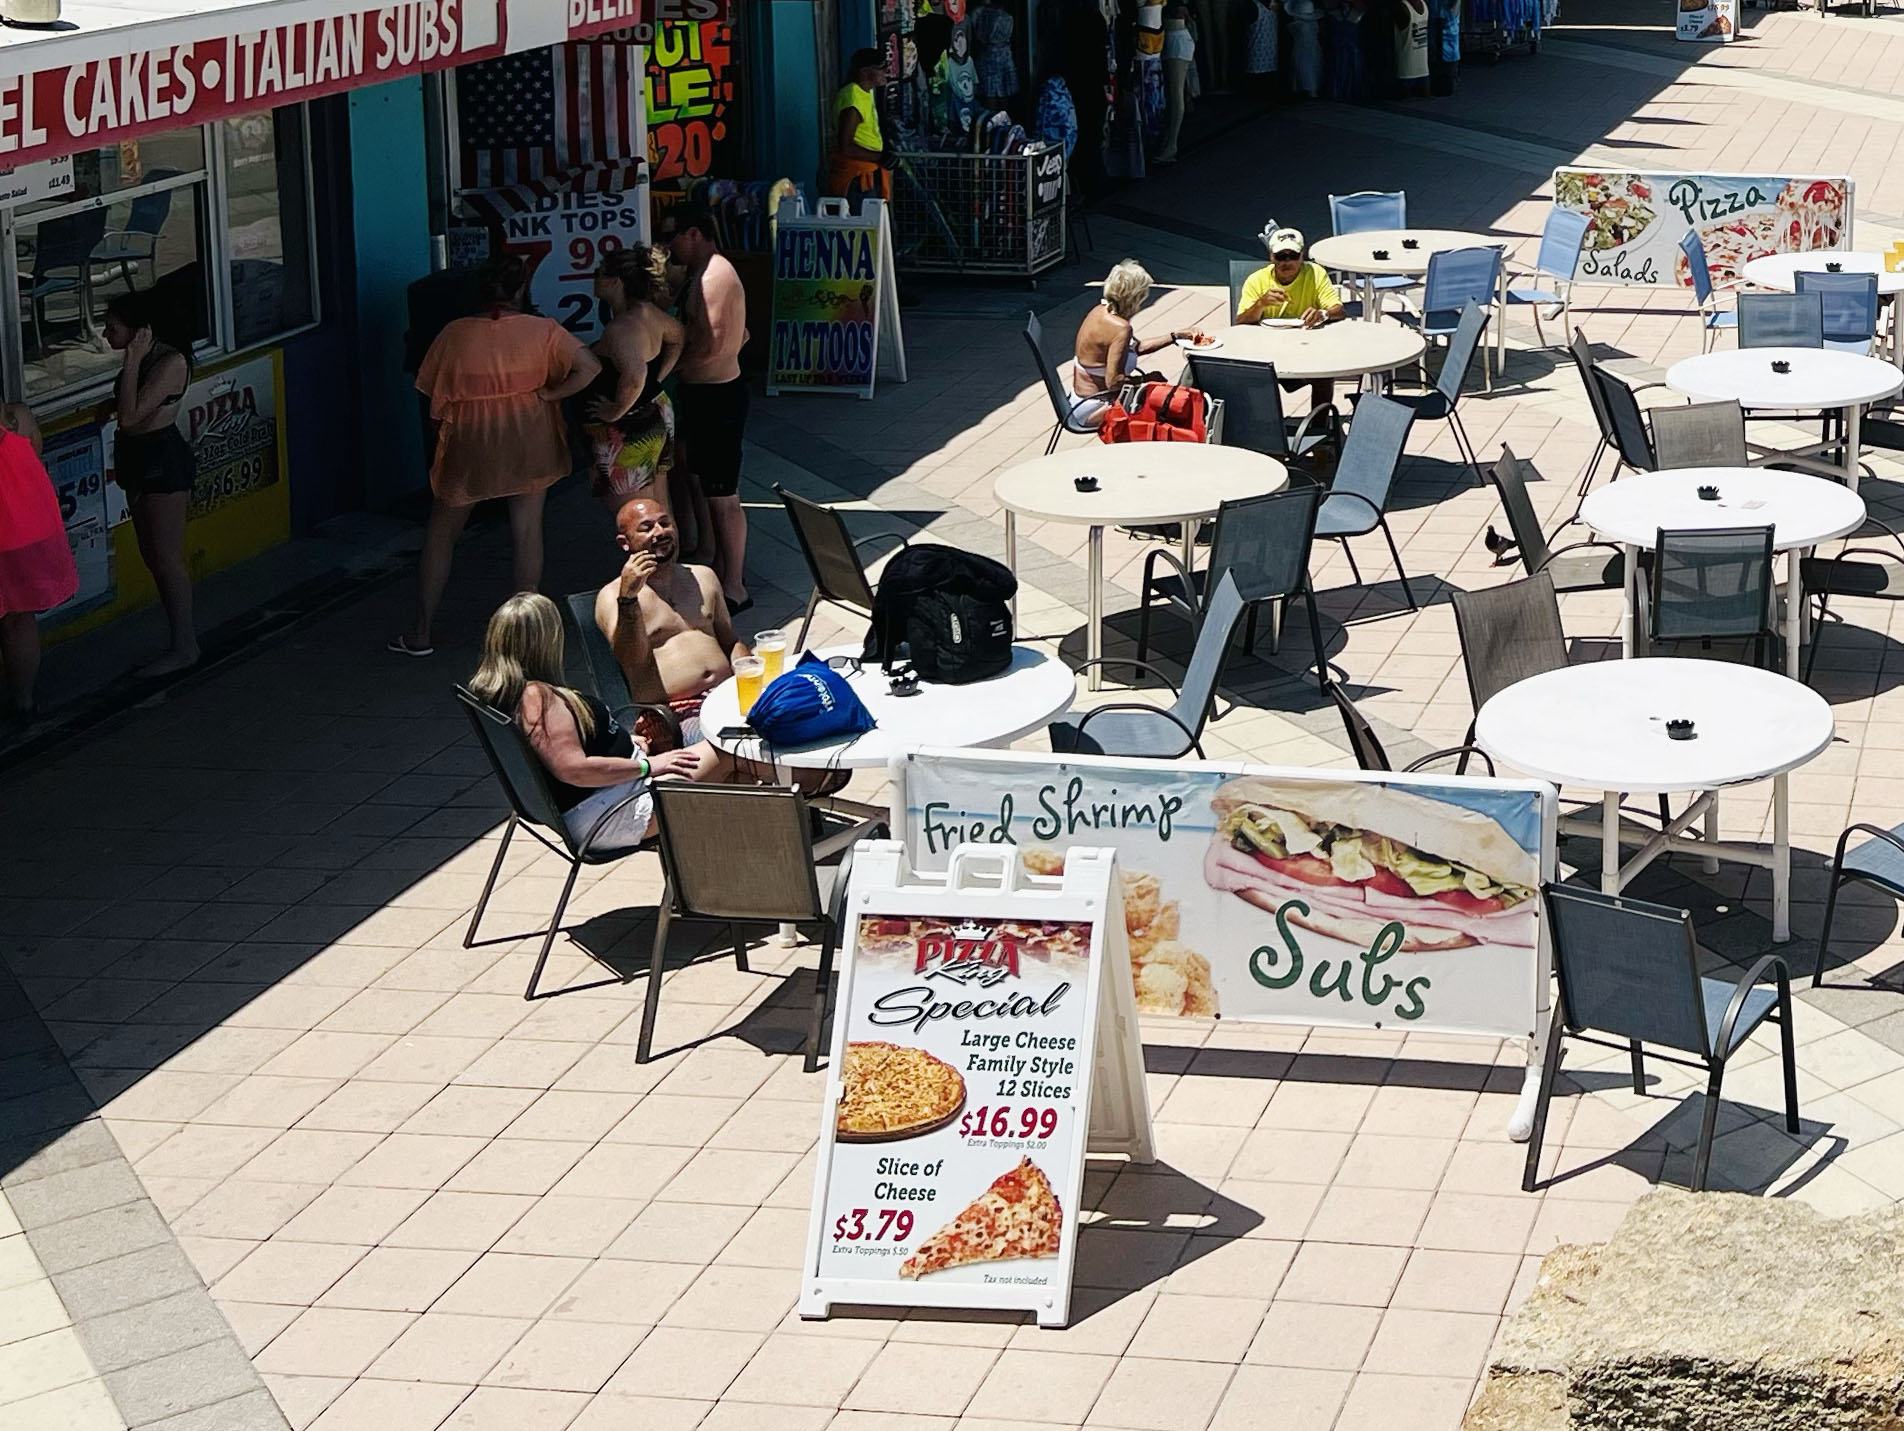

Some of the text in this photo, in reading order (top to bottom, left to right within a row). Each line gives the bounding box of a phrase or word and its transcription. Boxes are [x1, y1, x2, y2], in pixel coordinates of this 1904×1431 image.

[63, 43, 196, 138] CAKES
[225, 11, 364, 104] ITALIAN
[1669, 179, 1767, 225] Pizza
[560, 208, 637, 233] TOPS
[778, 229, 875, 280] HENNA
[1583, 249, 1658, 284] Salads
[775, 320, 873, 372] TATTOOS
[922, 776, 1183, 854] Fried Shrimp
[914, 938, 1021, 979] PIZZA
[924, 958, 1010, 988] King
[1248, 898, 1431, 1021] Subs
[868, 982, 1071, 1035] Special
[960, 1030, 1076, 1052] Large Cheese
[966, 1054, 1075, 1078] Family Style
[996, 1080, 1072, 1099] 12 Slices
[959, 1106, 1058, 1139] $16.99
[967, 1139, 987, 1148] Extra
[989, 1139, 1025, 1150] Toppings
[876, 1157, 944, 1177] Slice of
[874, 1182, 937, 1202] Cheese
[832, 1208, 914, 1242] $3.79
[832, 1245, 853, 1254] Extra
[854, 1246, 891, 1257] Toppings
[983, 1274, 1048, 1286] Tax not included
